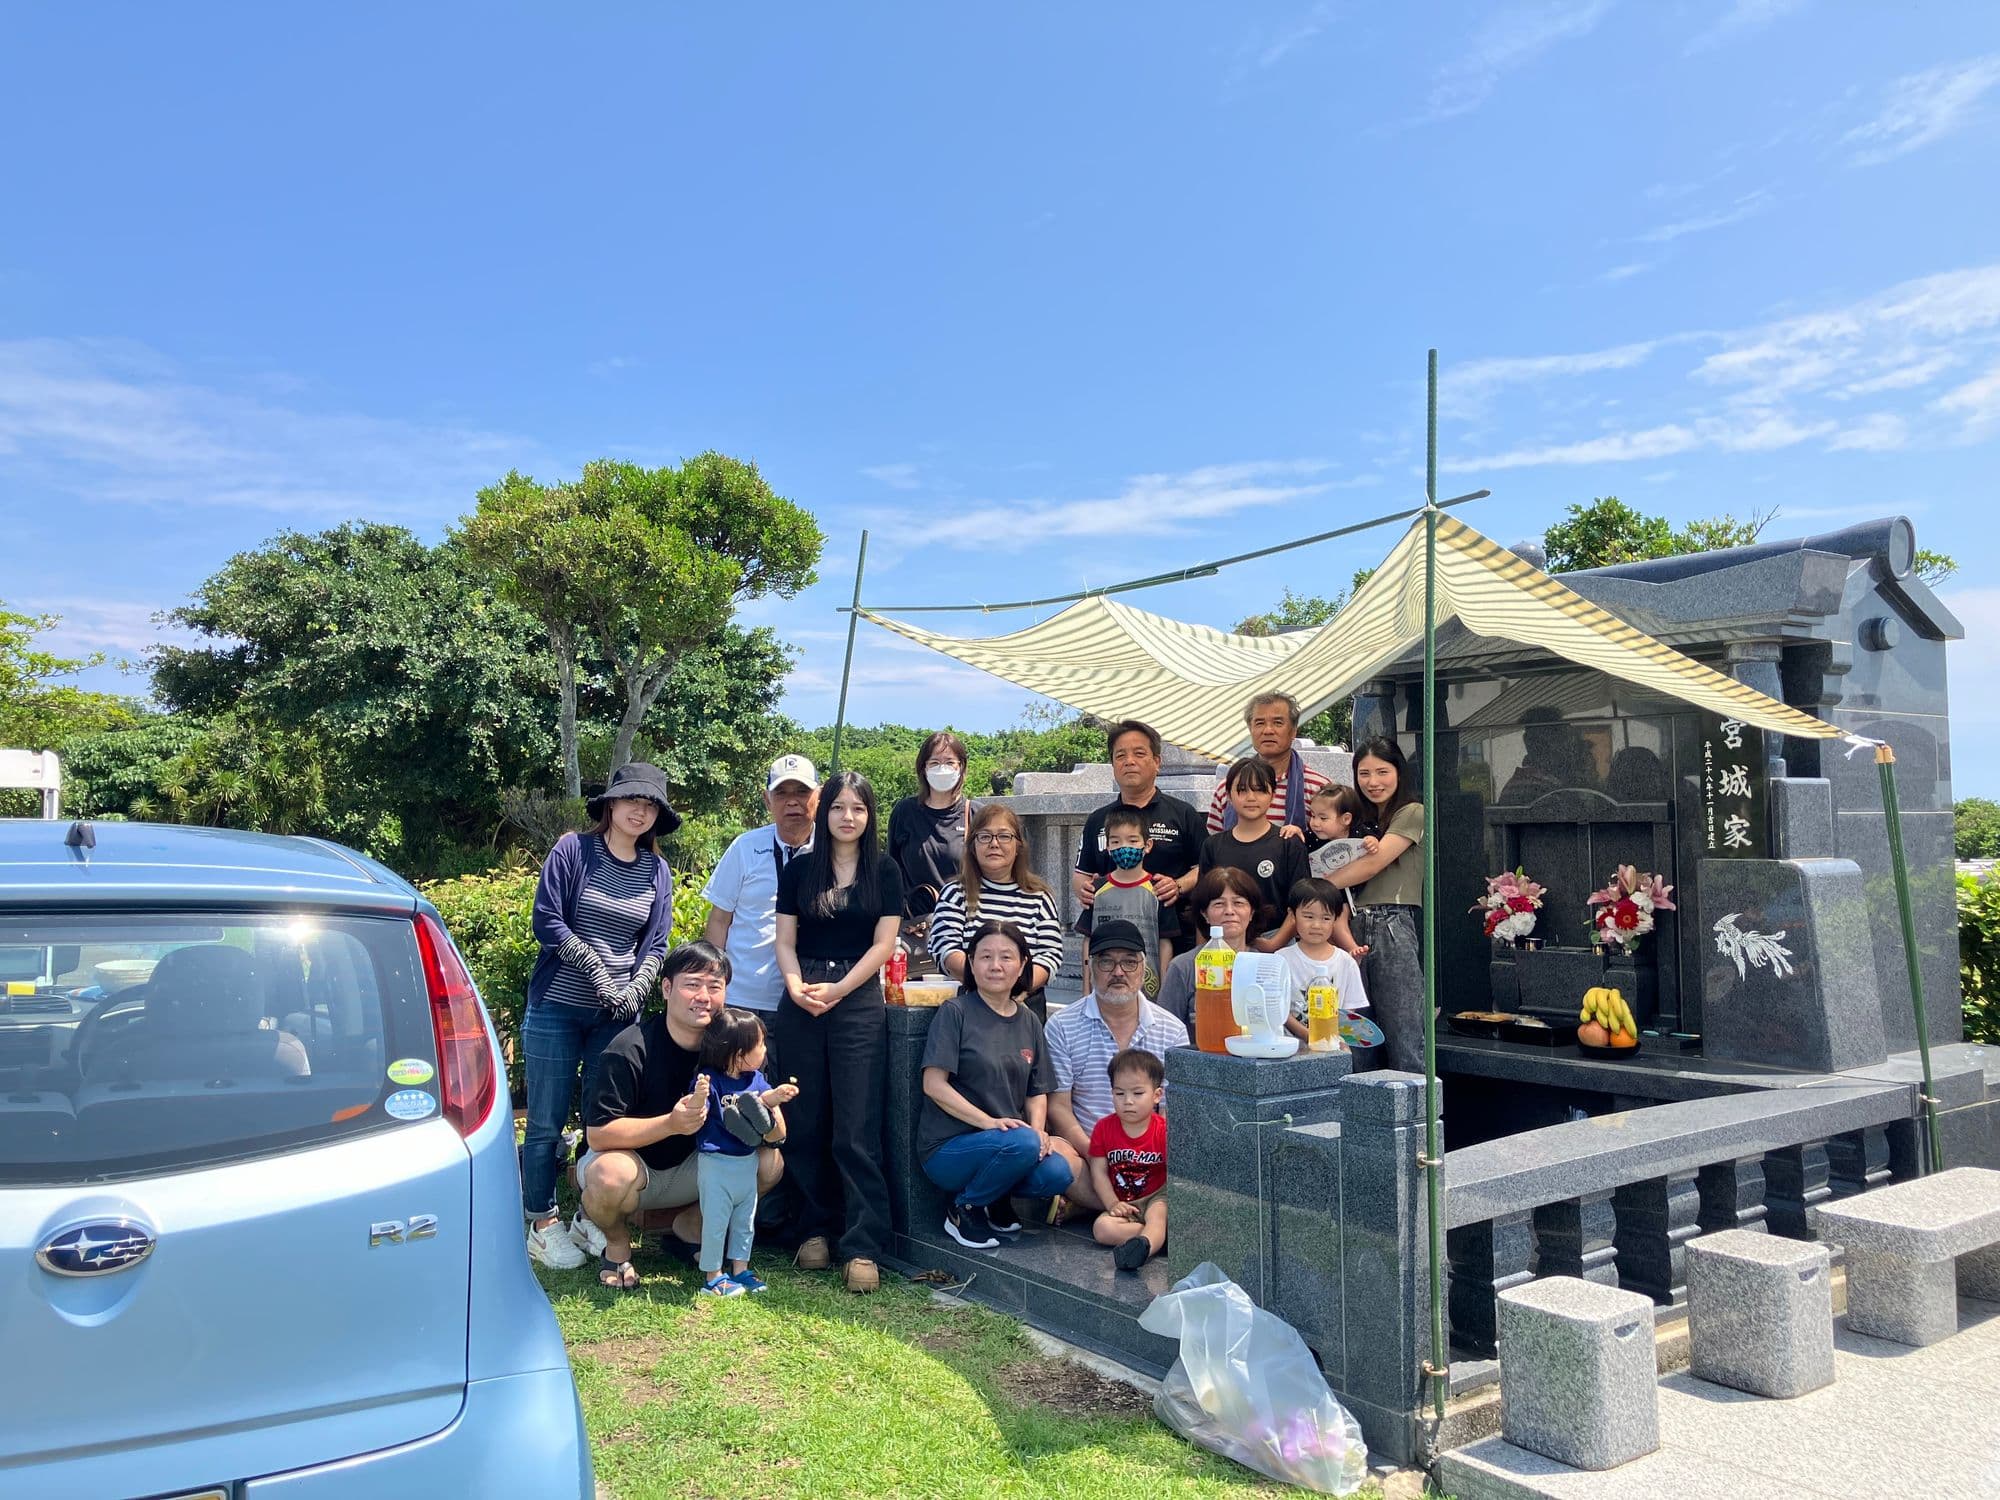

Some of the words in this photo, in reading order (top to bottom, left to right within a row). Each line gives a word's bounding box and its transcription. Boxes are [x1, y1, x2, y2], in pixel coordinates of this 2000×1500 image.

[1703, 740, 1716, 849] 平成二十八年十一月吉日建立
[1718, 718, 1753, 849] 宮城家
[369, 1213, 439, 1246] R2
